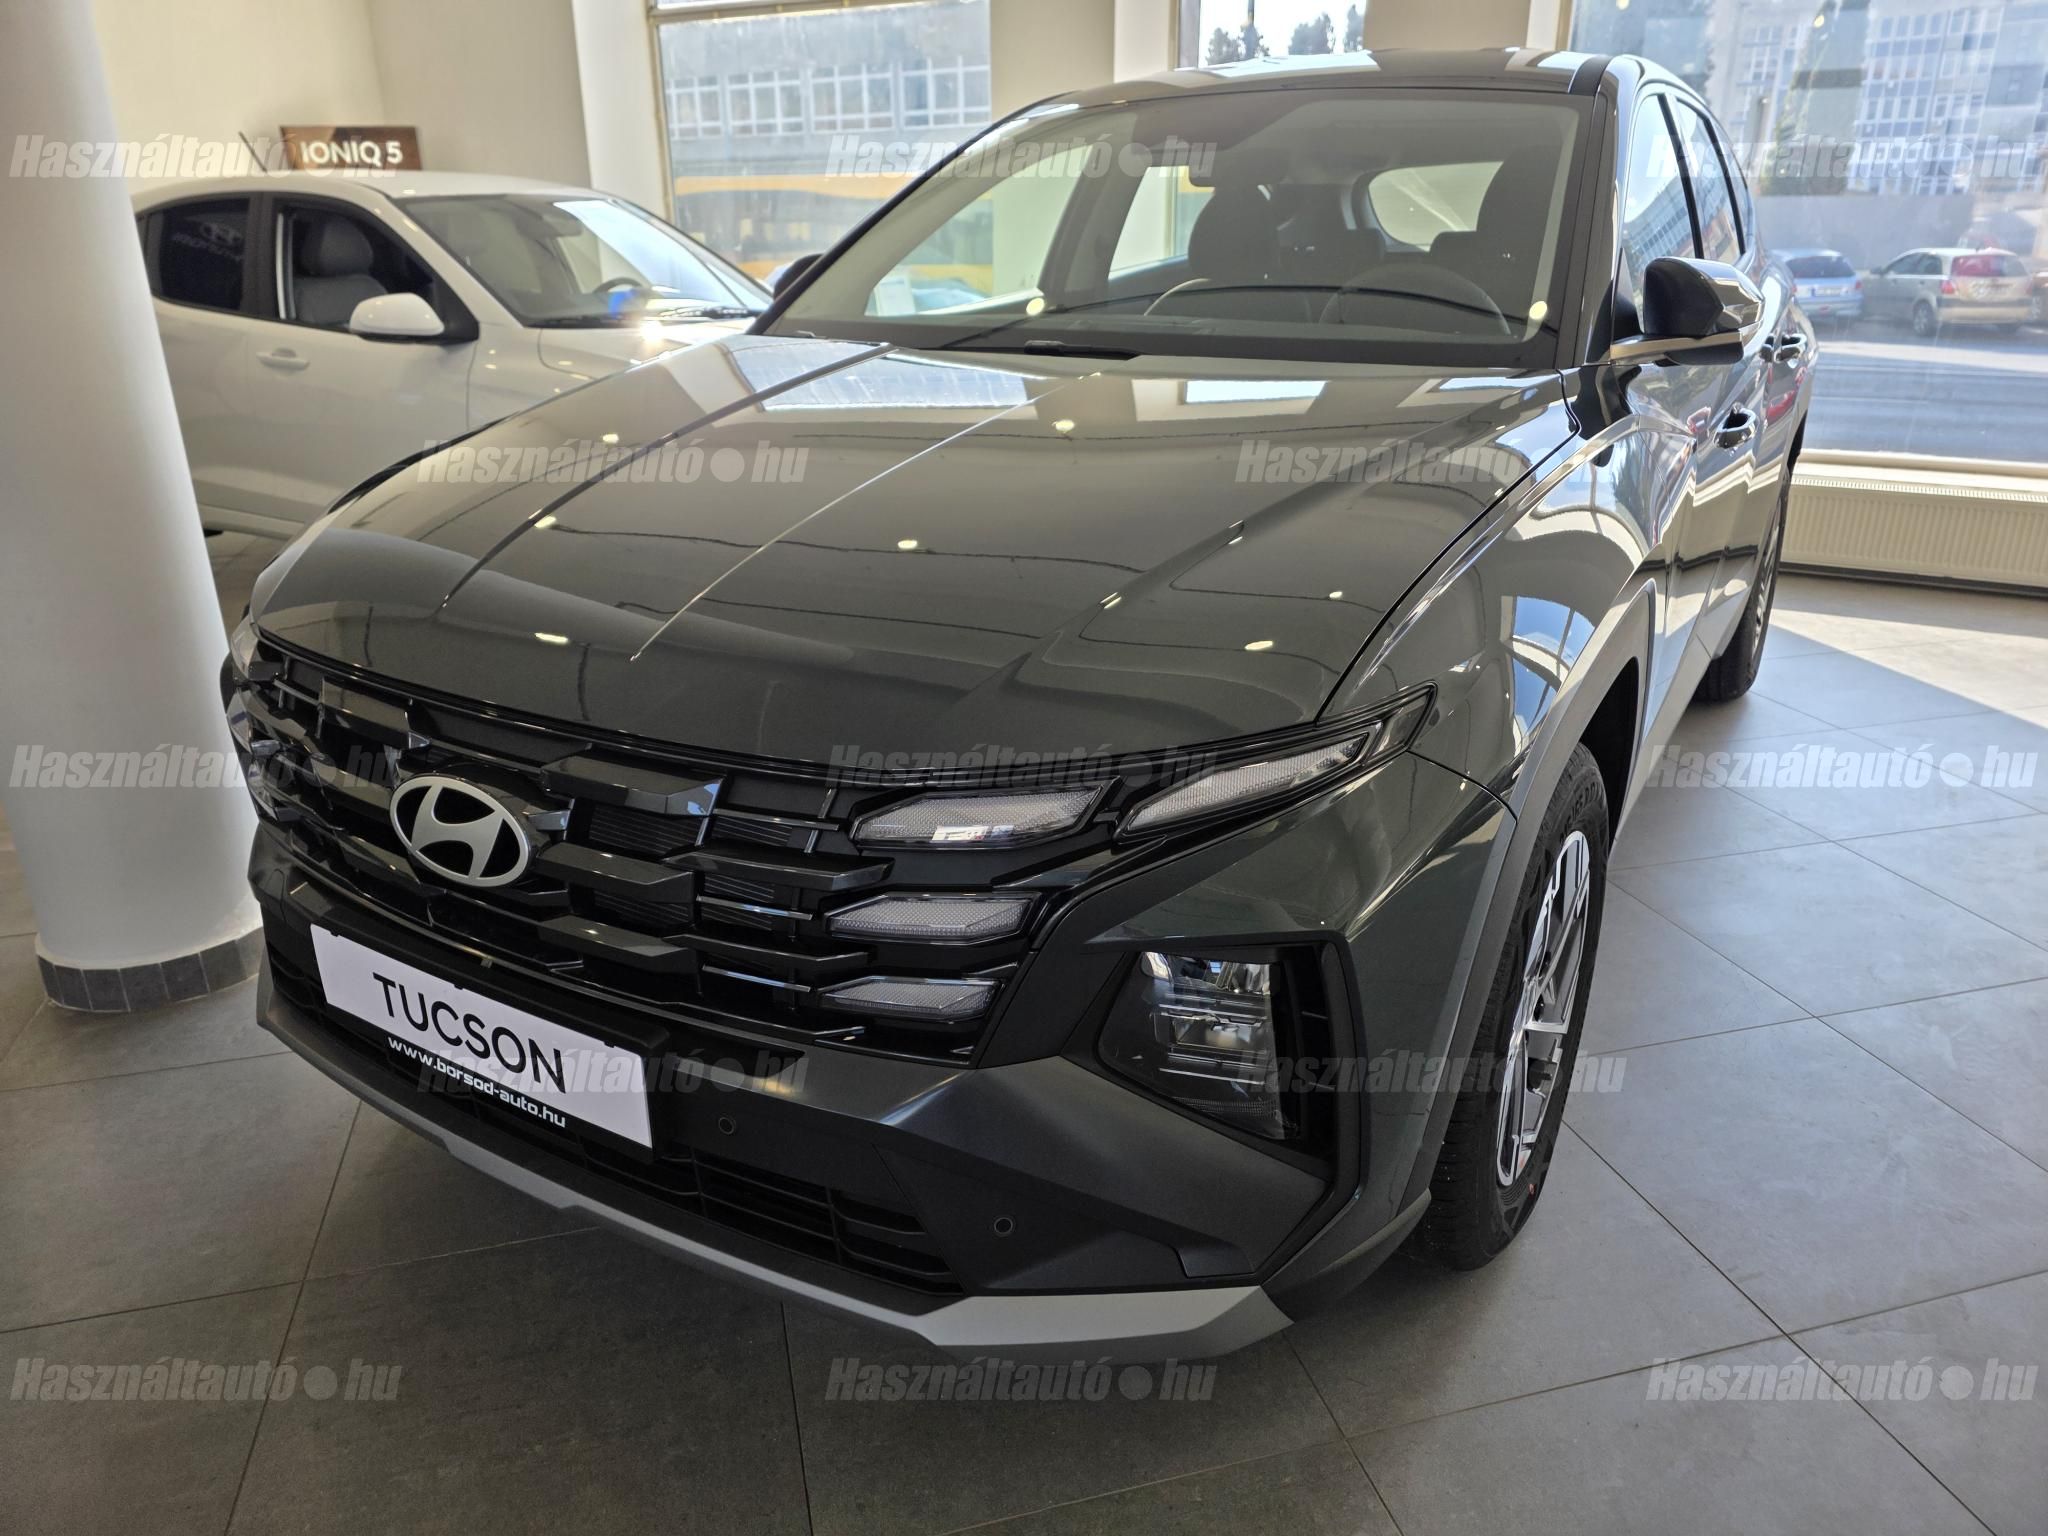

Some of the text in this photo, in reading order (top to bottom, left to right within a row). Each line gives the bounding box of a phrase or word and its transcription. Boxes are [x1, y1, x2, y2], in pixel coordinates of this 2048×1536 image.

[300, 141, 403, 168] IONIQ 5
[373, 972, 566, 1094] TUCSON
[388, 1036, 566, 1128] www.borsod-auto.hu
